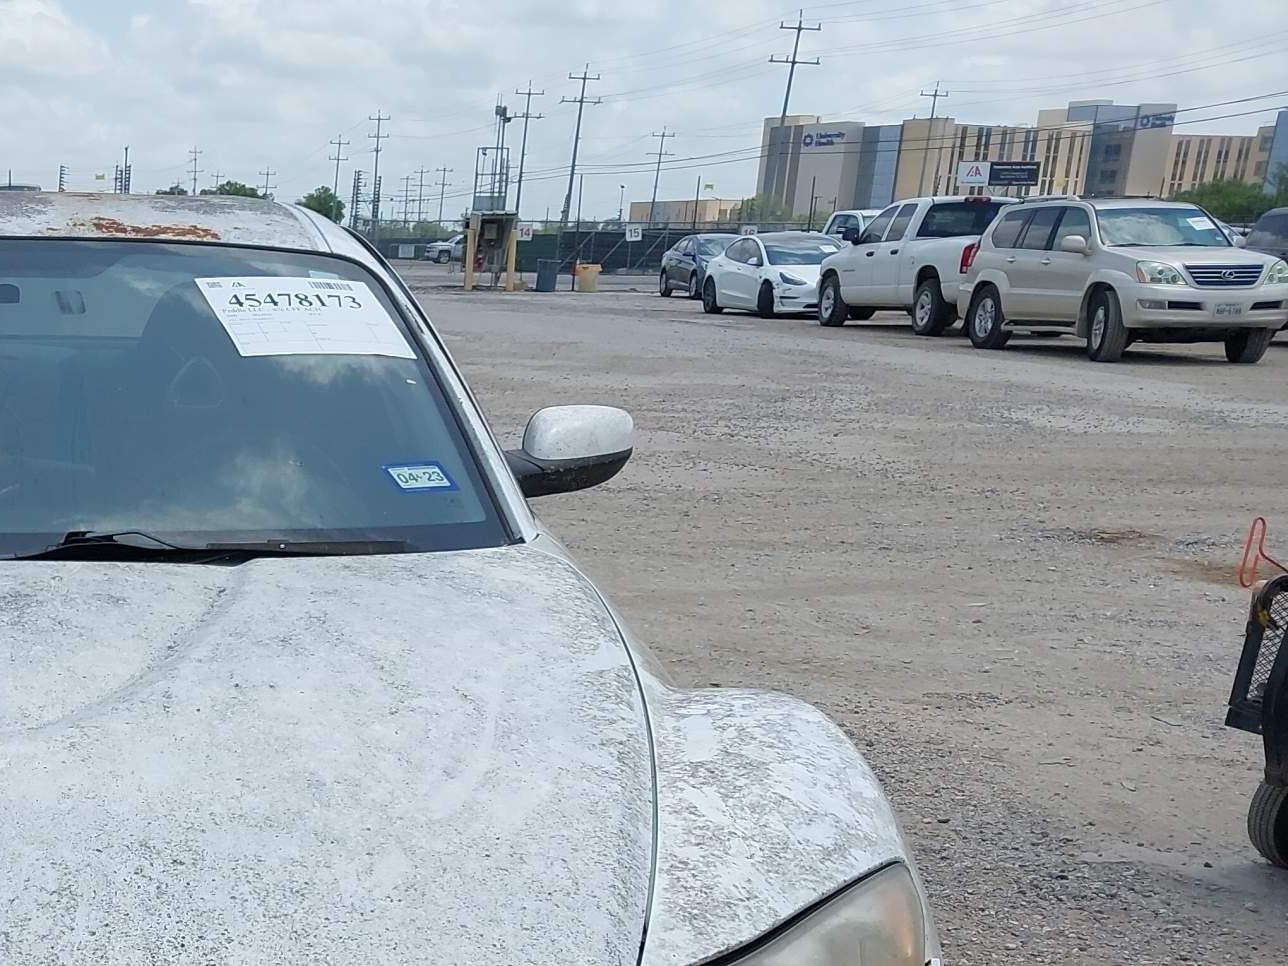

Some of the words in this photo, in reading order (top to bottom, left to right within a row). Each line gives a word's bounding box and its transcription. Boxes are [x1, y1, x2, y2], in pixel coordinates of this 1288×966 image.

[520, 227, 531, 238] 14
[629, 227, 640, 238] 15
[228, 293, 362, 309] 45478173
[396, 472, 419, 484] 04
[422, 470, 445, 482] 23
